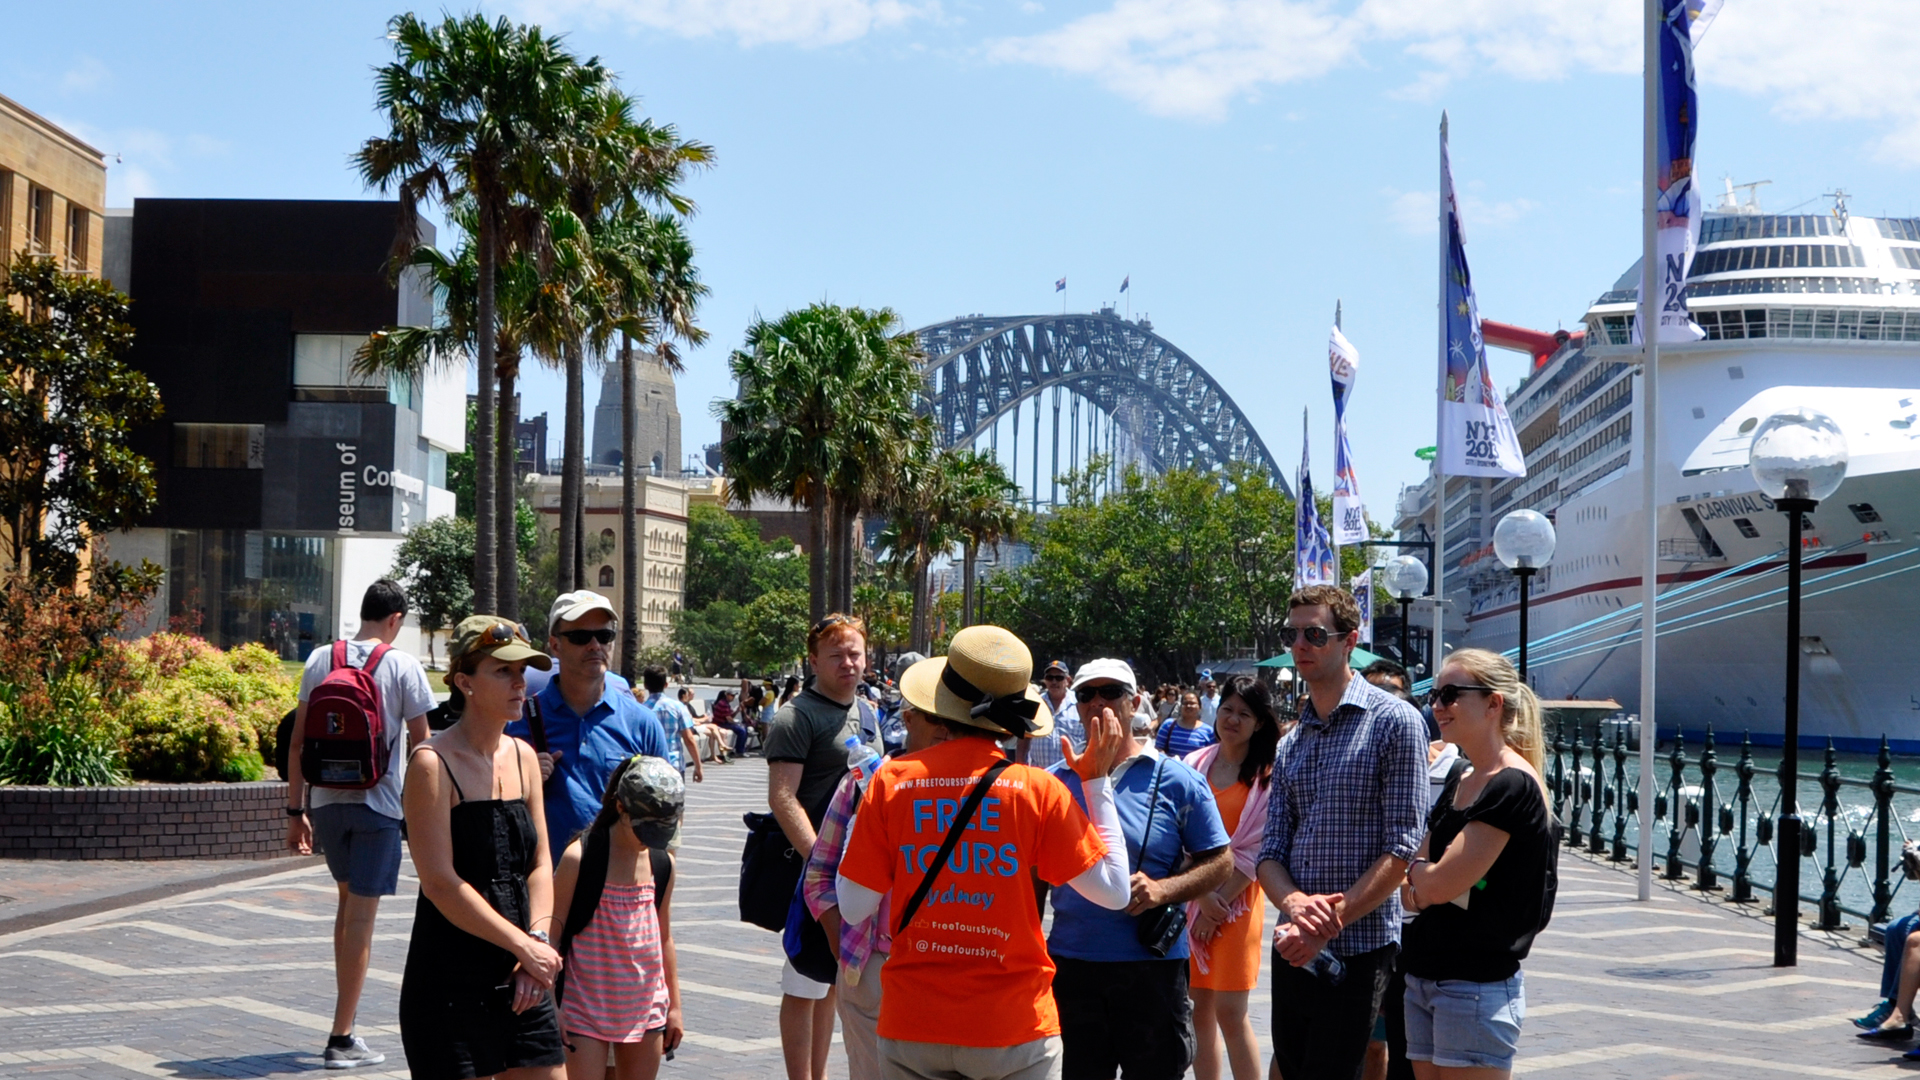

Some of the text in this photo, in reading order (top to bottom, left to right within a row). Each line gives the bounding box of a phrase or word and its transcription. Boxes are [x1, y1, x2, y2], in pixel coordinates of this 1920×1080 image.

[336, 442, 357, 466] of
[1696, 495, 1764, 521] CARNIVAL
[898, 841, 1019, 877] TOURS
[925, 883, 995, 911] ydney
